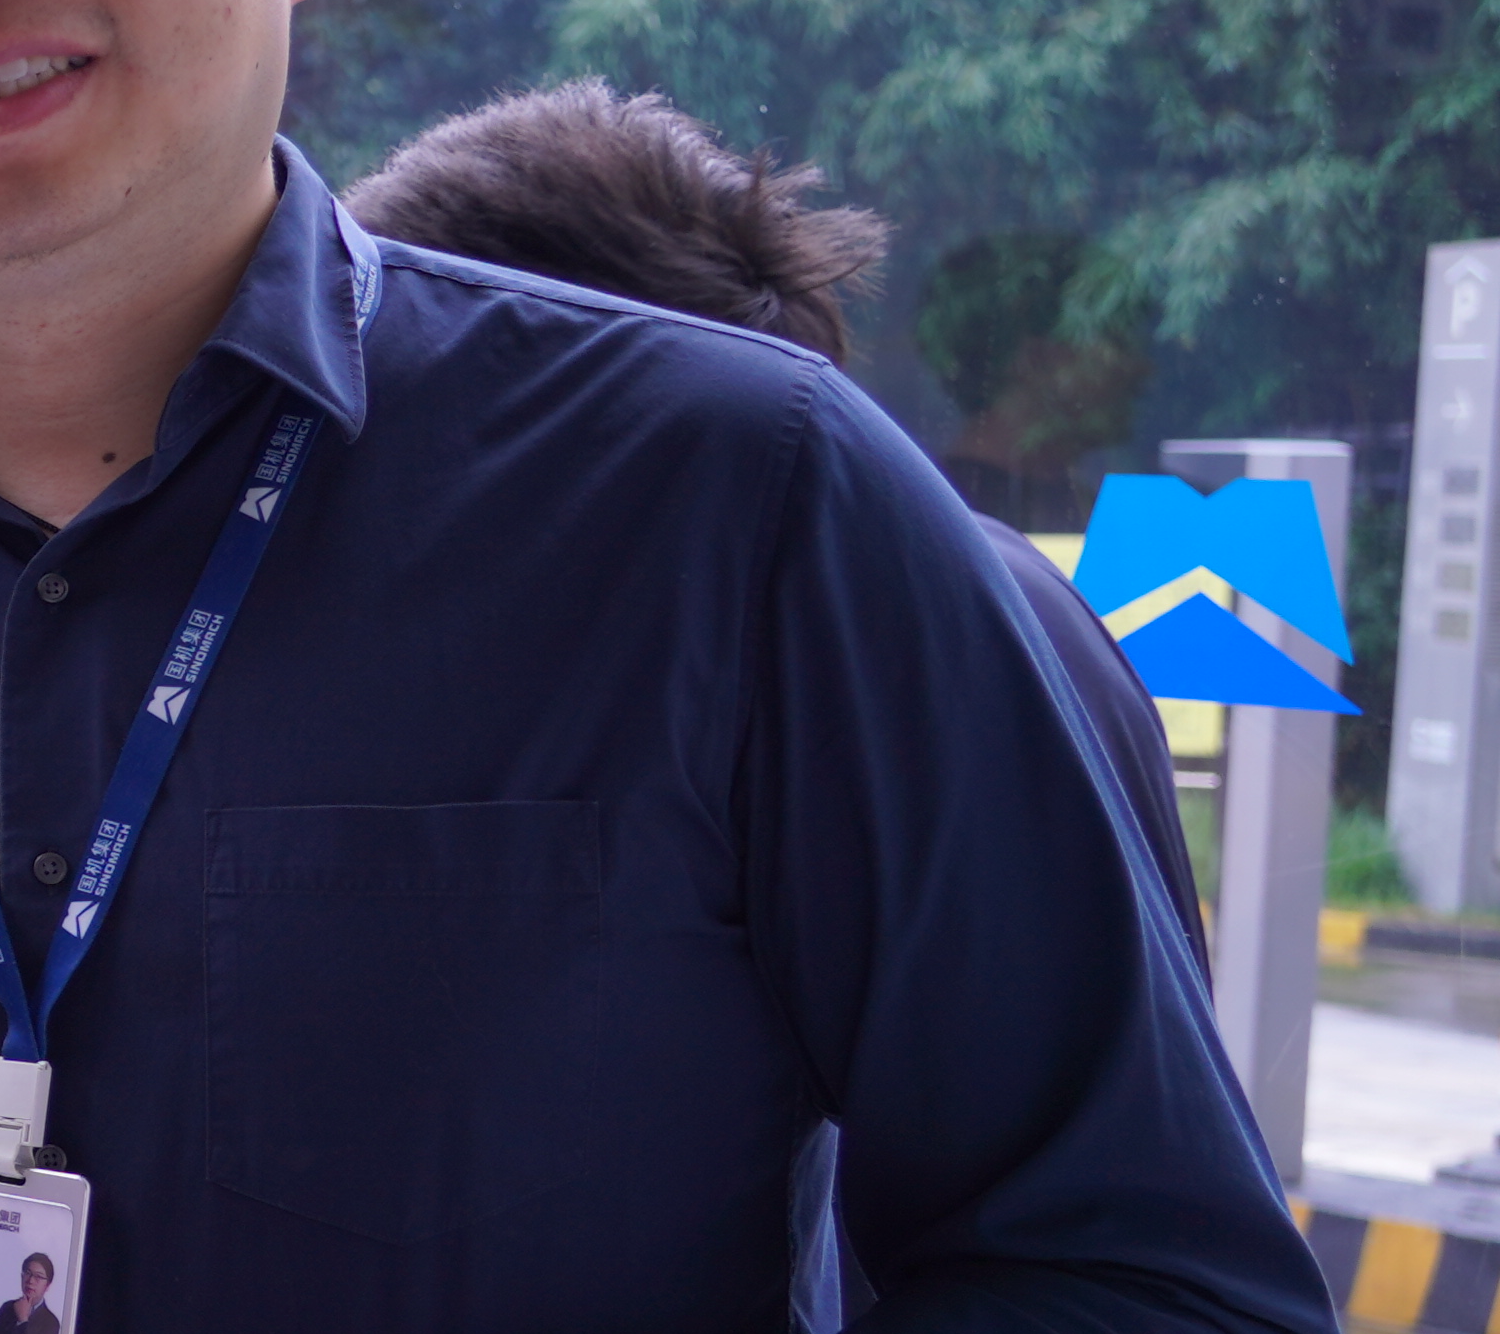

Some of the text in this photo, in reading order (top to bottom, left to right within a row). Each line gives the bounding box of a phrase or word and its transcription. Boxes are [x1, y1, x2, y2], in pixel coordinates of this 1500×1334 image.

[255, 413, 299, 482] 国机集团
[275, 416, 314, 485] SINOMACH
[164, 608, 213, 681] 国机集团
[184, 613, 225, 684] SINOMACH
[77, 818, 120, 894] 国机集团
[93, 822, 132, 898] SINOMACH
